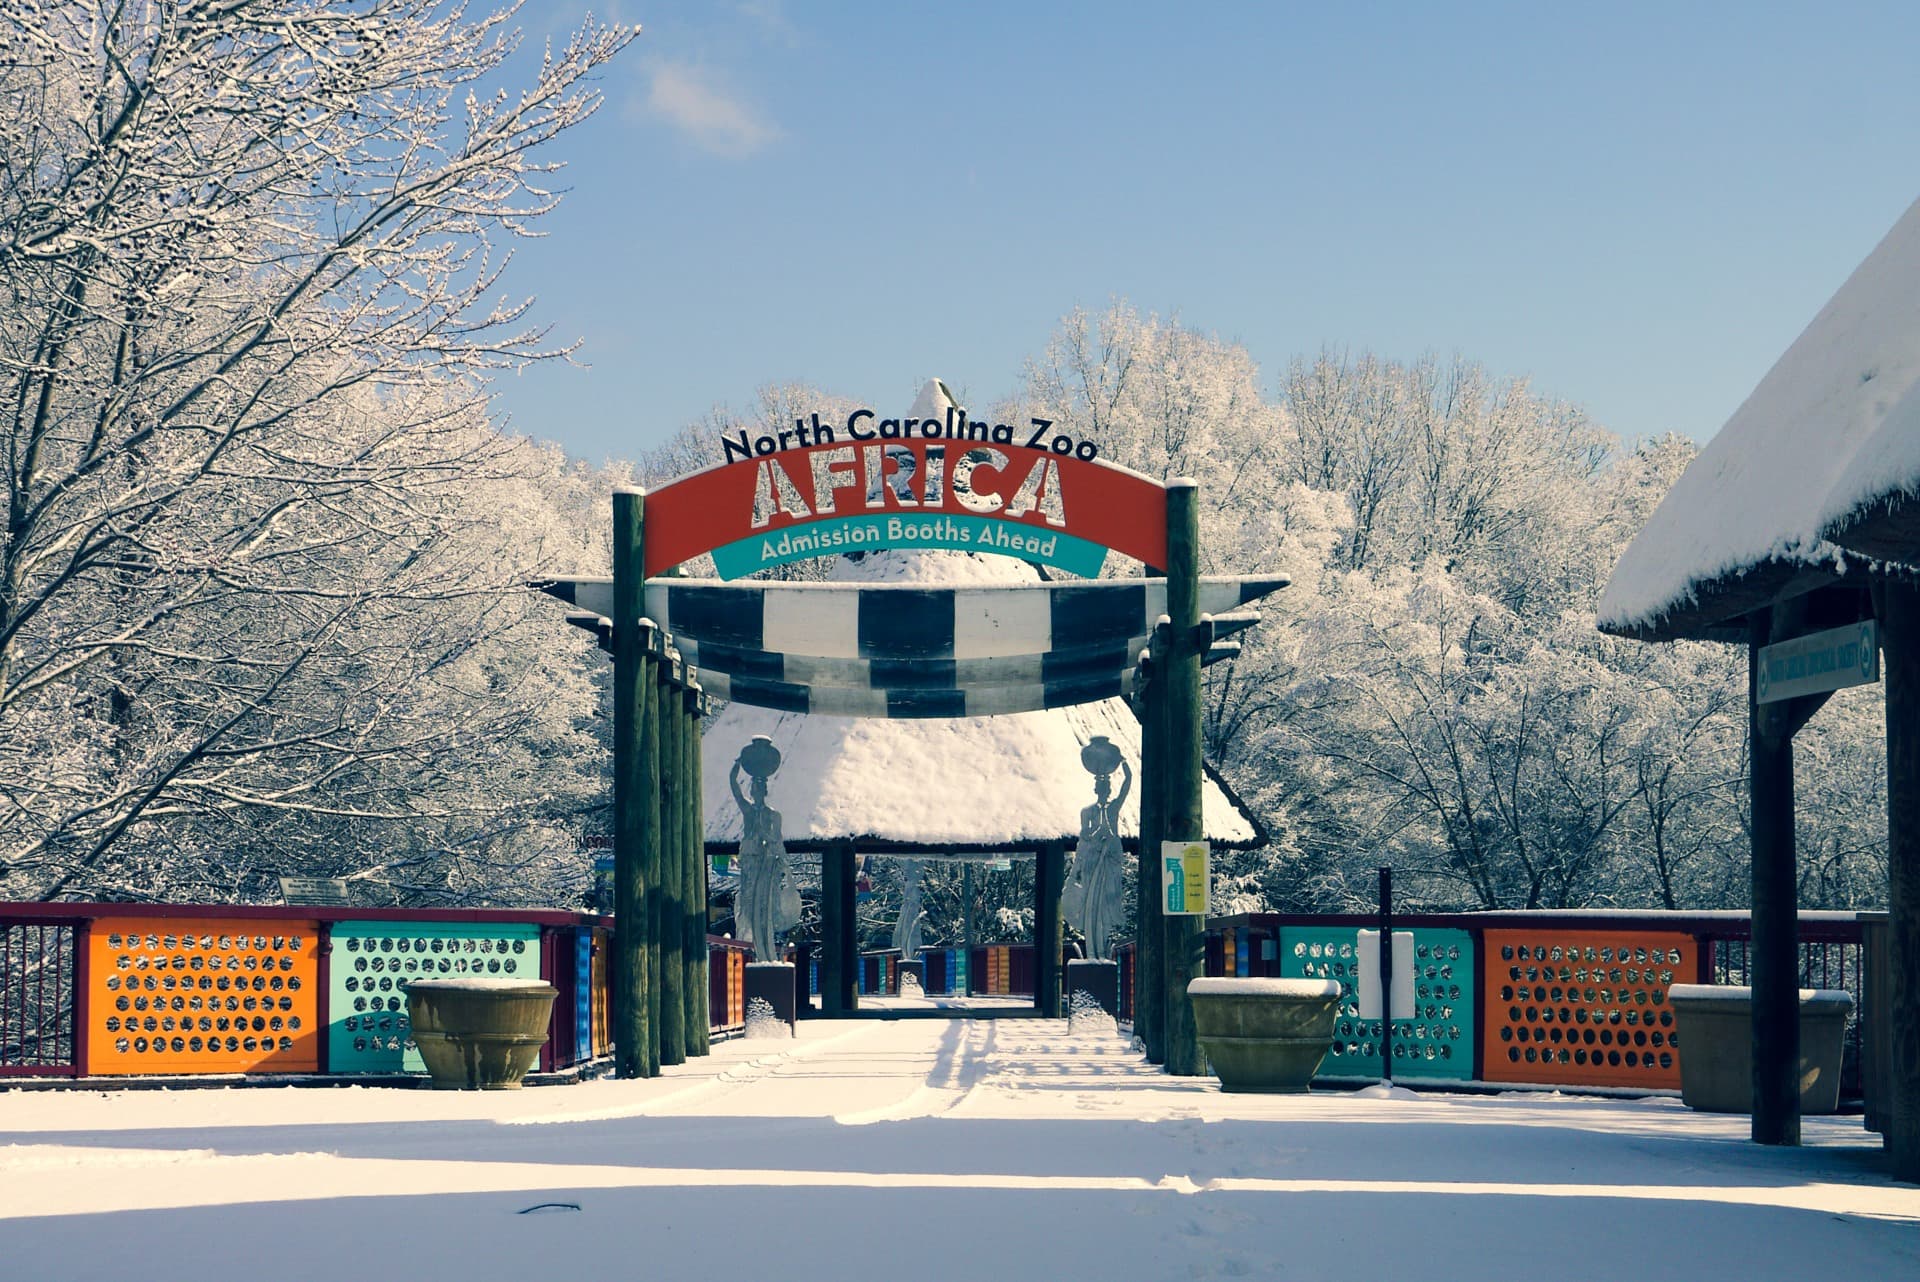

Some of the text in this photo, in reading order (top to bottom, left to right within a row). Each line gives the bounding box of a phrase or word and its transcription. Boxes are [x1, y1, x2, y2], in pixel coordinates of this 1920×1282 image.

[721, 407, 1098, 465] North Carolina Zoo
[751, 444, 1066, 529] AFRICA
[761, 517, 1057, 561] Admission Booths Ahead
